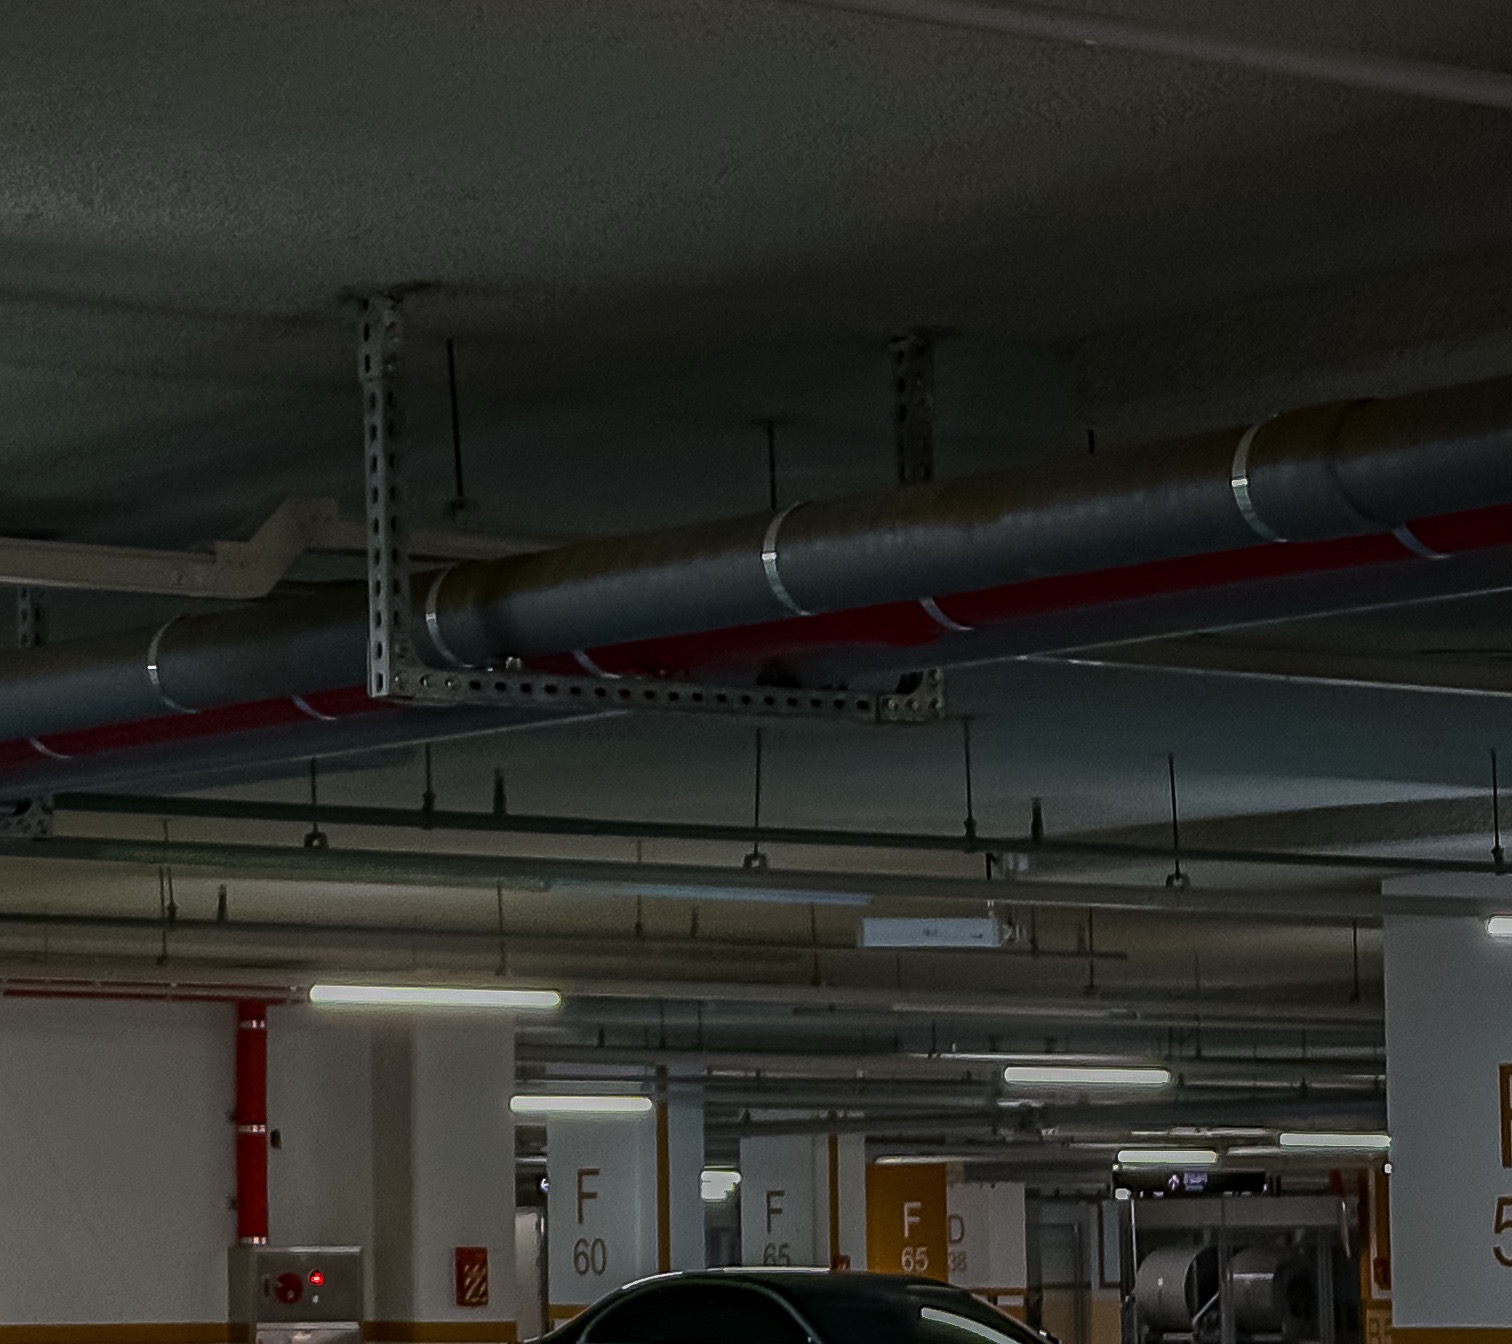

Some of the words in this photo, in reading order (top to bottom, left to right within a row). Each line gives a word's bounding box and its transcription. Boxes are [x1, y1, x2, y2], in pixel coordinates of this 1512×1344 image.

[577, 1168, 600, 1224] F
[766, 1190, 786, 1233] F
[903, 1201, 921, 1238] F
[948, 1214, 965, 1243] D
[574, 1238, 607, 1275] 60
[901, 1246, 929, 1272] 65
